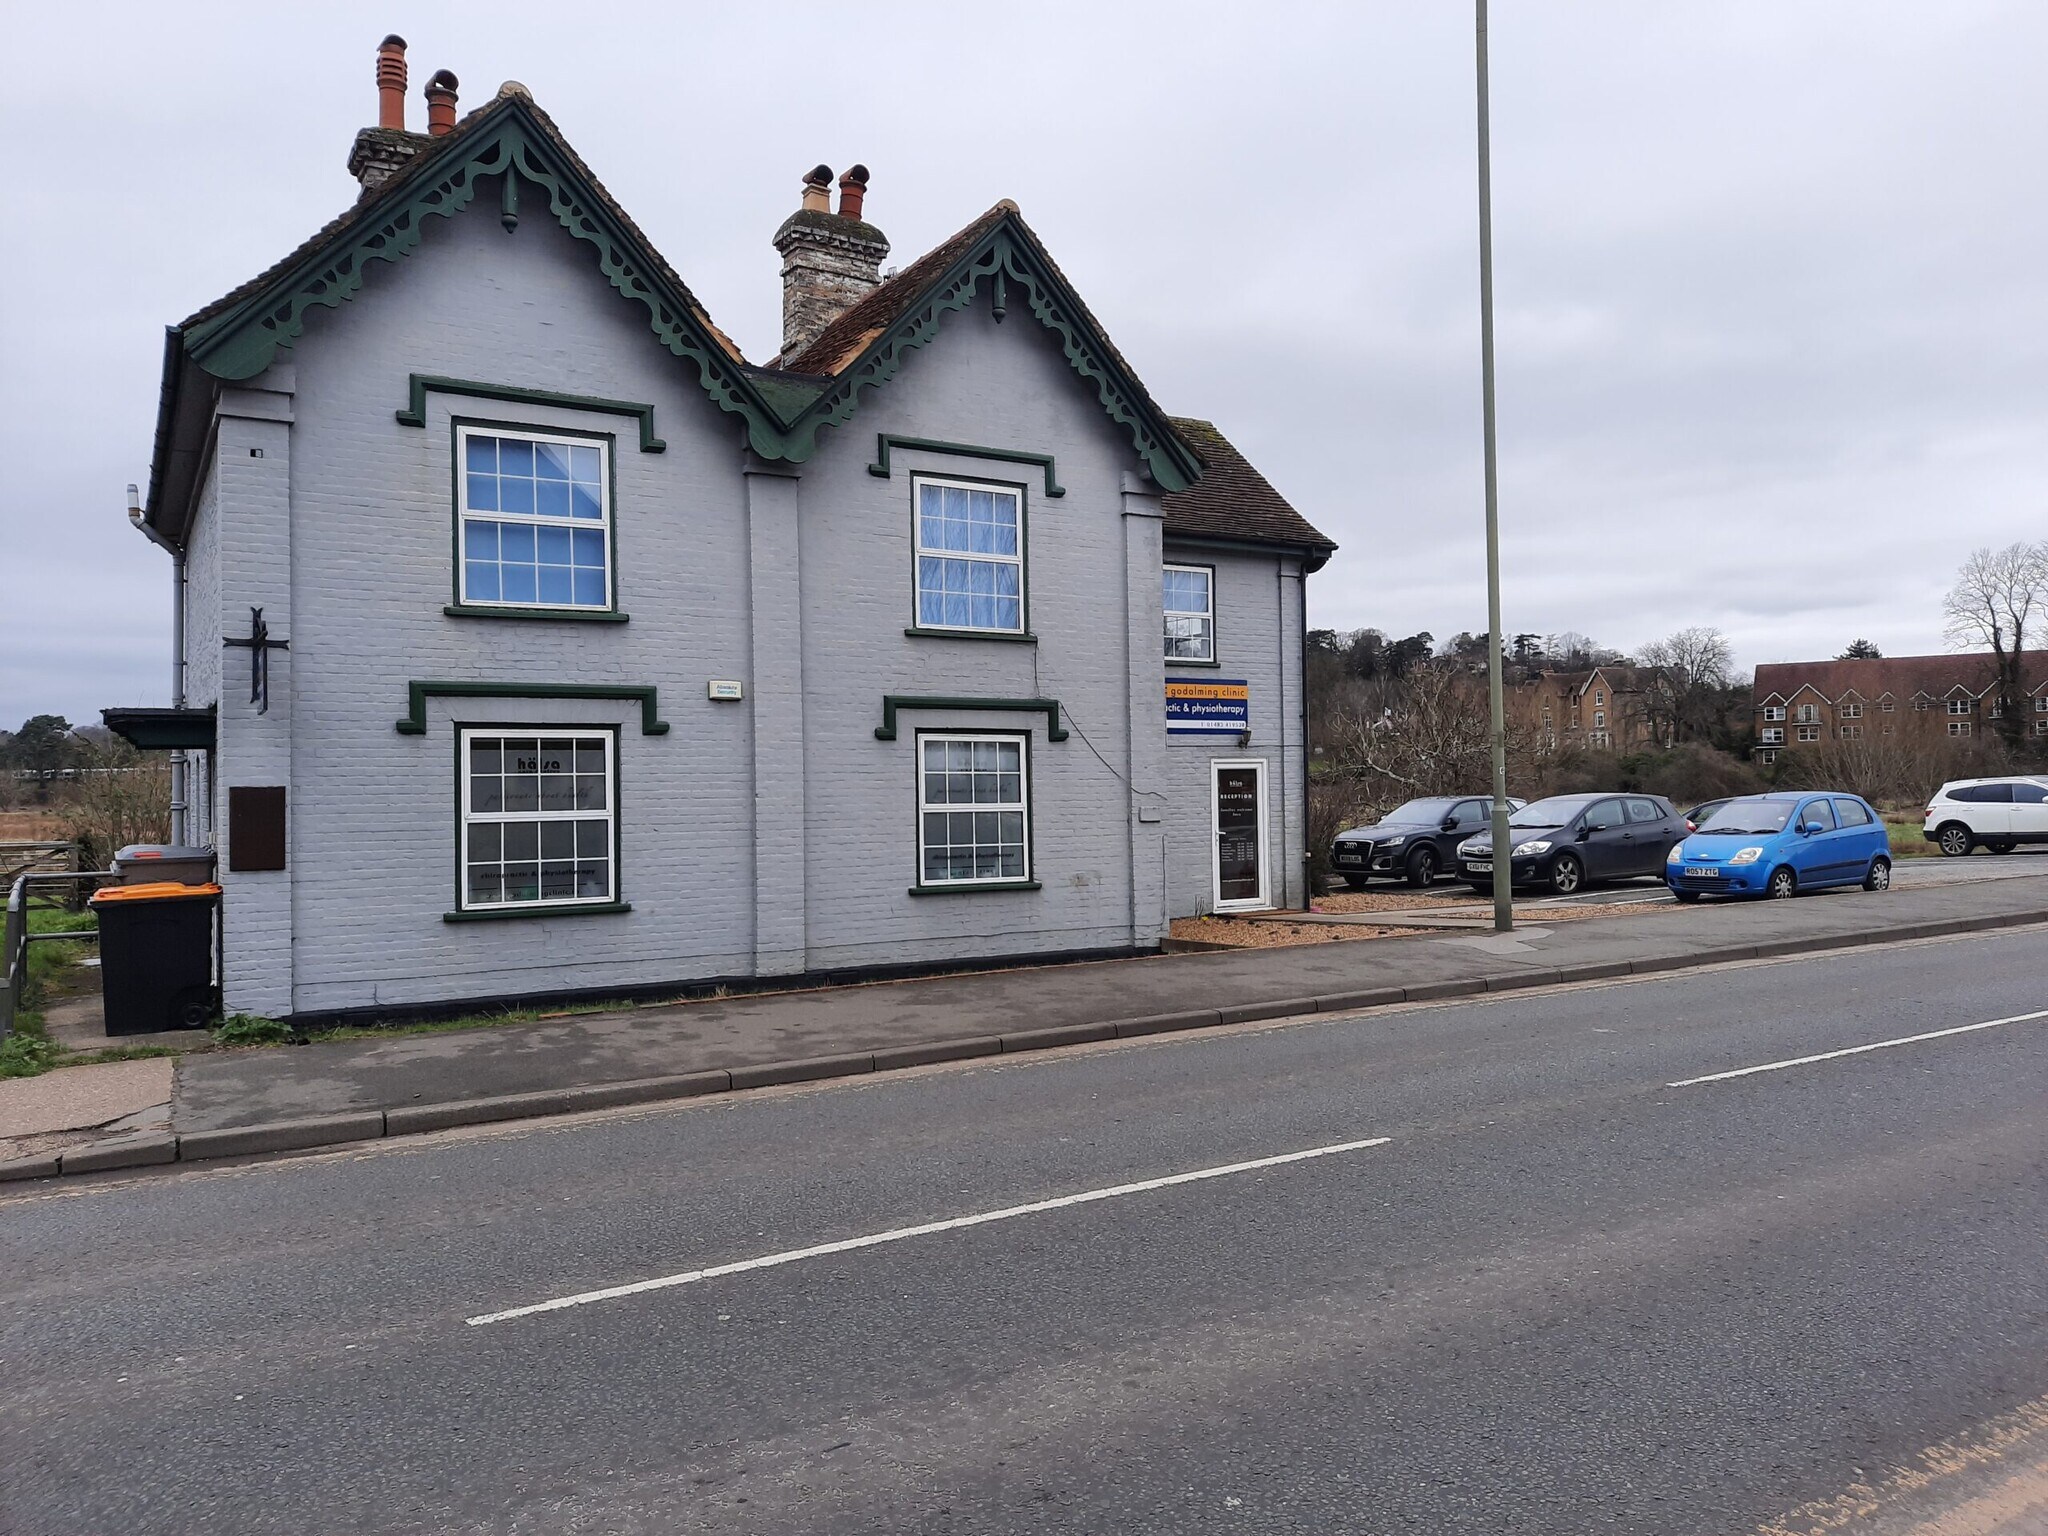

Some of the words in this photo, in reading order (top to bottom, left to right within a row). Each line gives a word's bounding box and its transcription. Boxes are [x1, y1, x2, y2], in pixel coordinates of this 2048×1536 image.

[1171, 686, 1218, 698] godalming
[1222, 687, 1245, 697] clinic
[1183, 703, 1189, 712] &
[1192, 703, 1244, 714] physiotherapy
